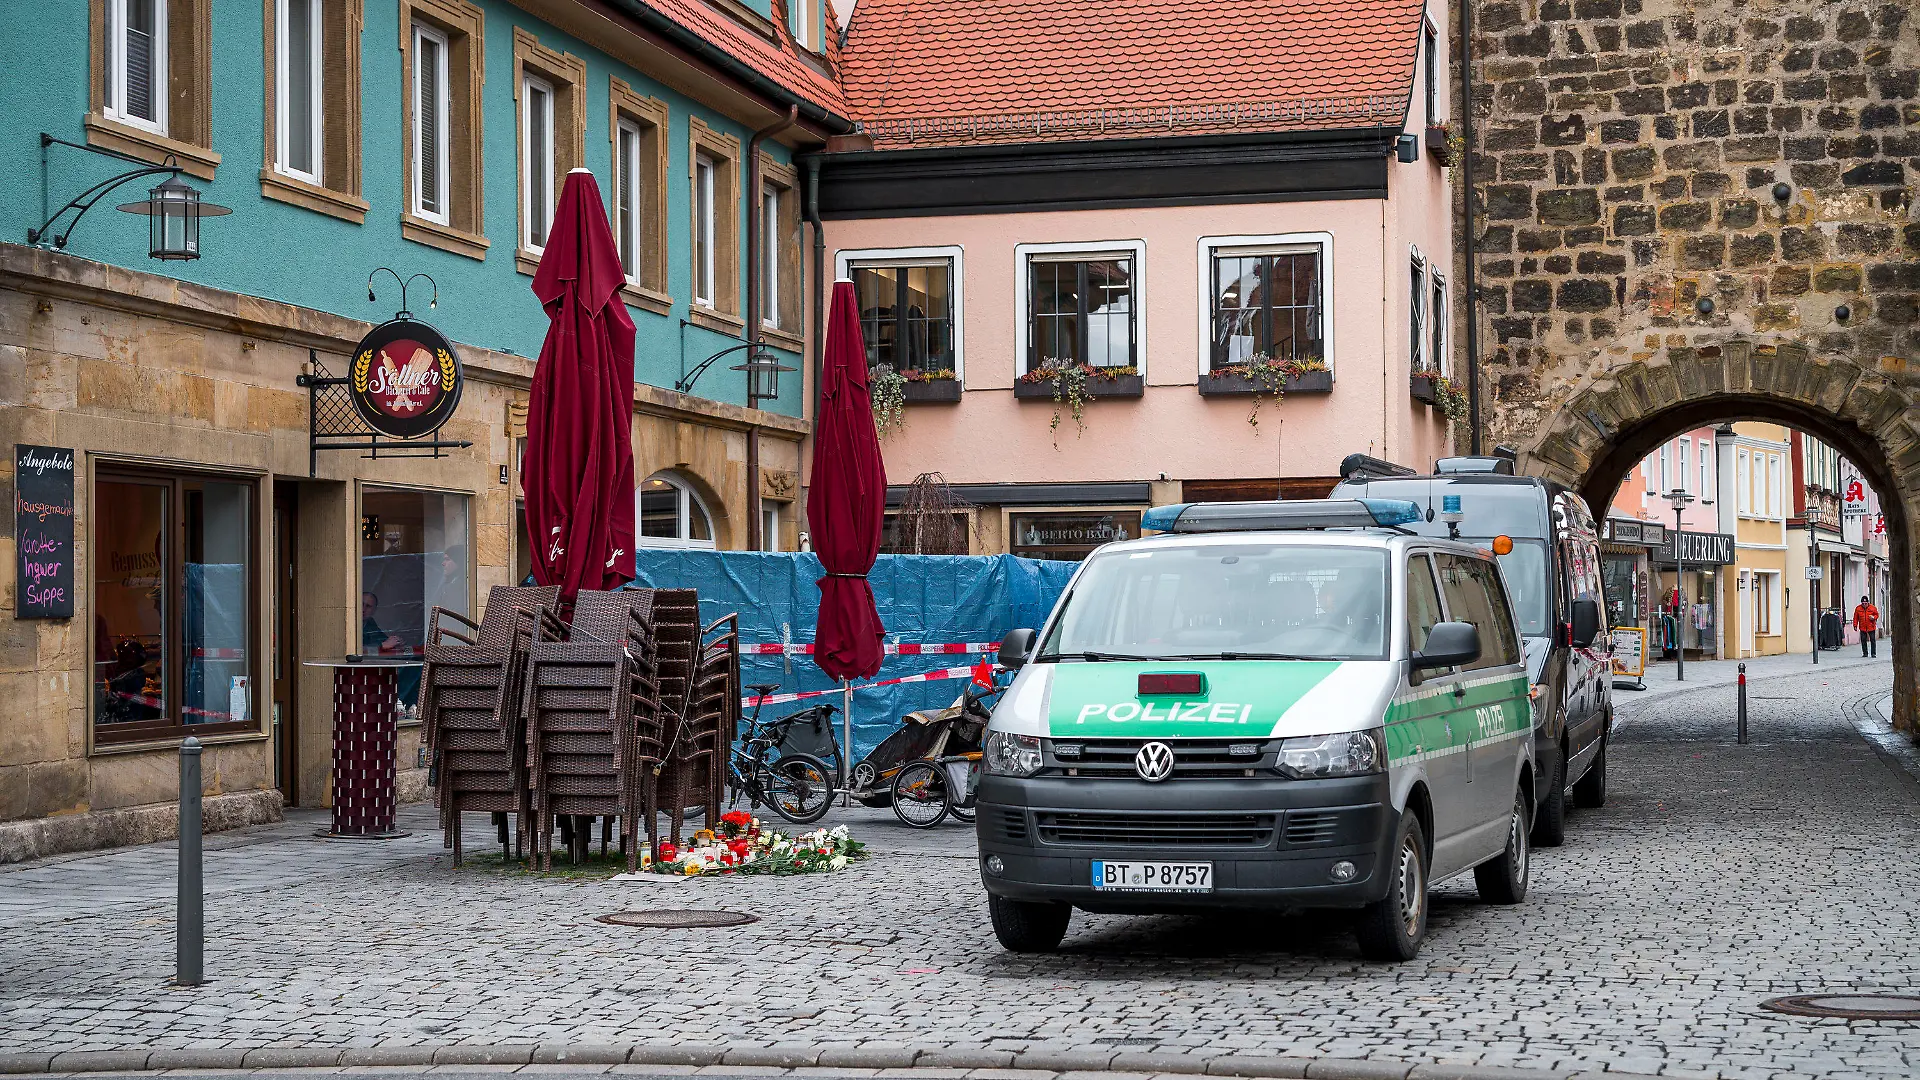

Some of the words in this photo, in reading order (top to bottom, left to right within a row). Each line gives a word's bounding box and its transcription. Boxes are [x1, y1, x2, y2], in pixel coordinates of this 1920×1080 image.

[368, 364, 441, 394] Söllner
[18, 449, 73, 476] Angebote
[24, 556, 62, 584] Ingwer
[111, 550, 157, 572] Genuss
[27, 584, 65, 609] Suppe
[1076, 702, 1252, 724] POLIZEI
[1475, 704, 1506, 739] POLIZEI
[1105, 864, 1130, 884] BT
[1143, 865, 1156, 885] P
[1160, 865, 1210, 886] 8757
